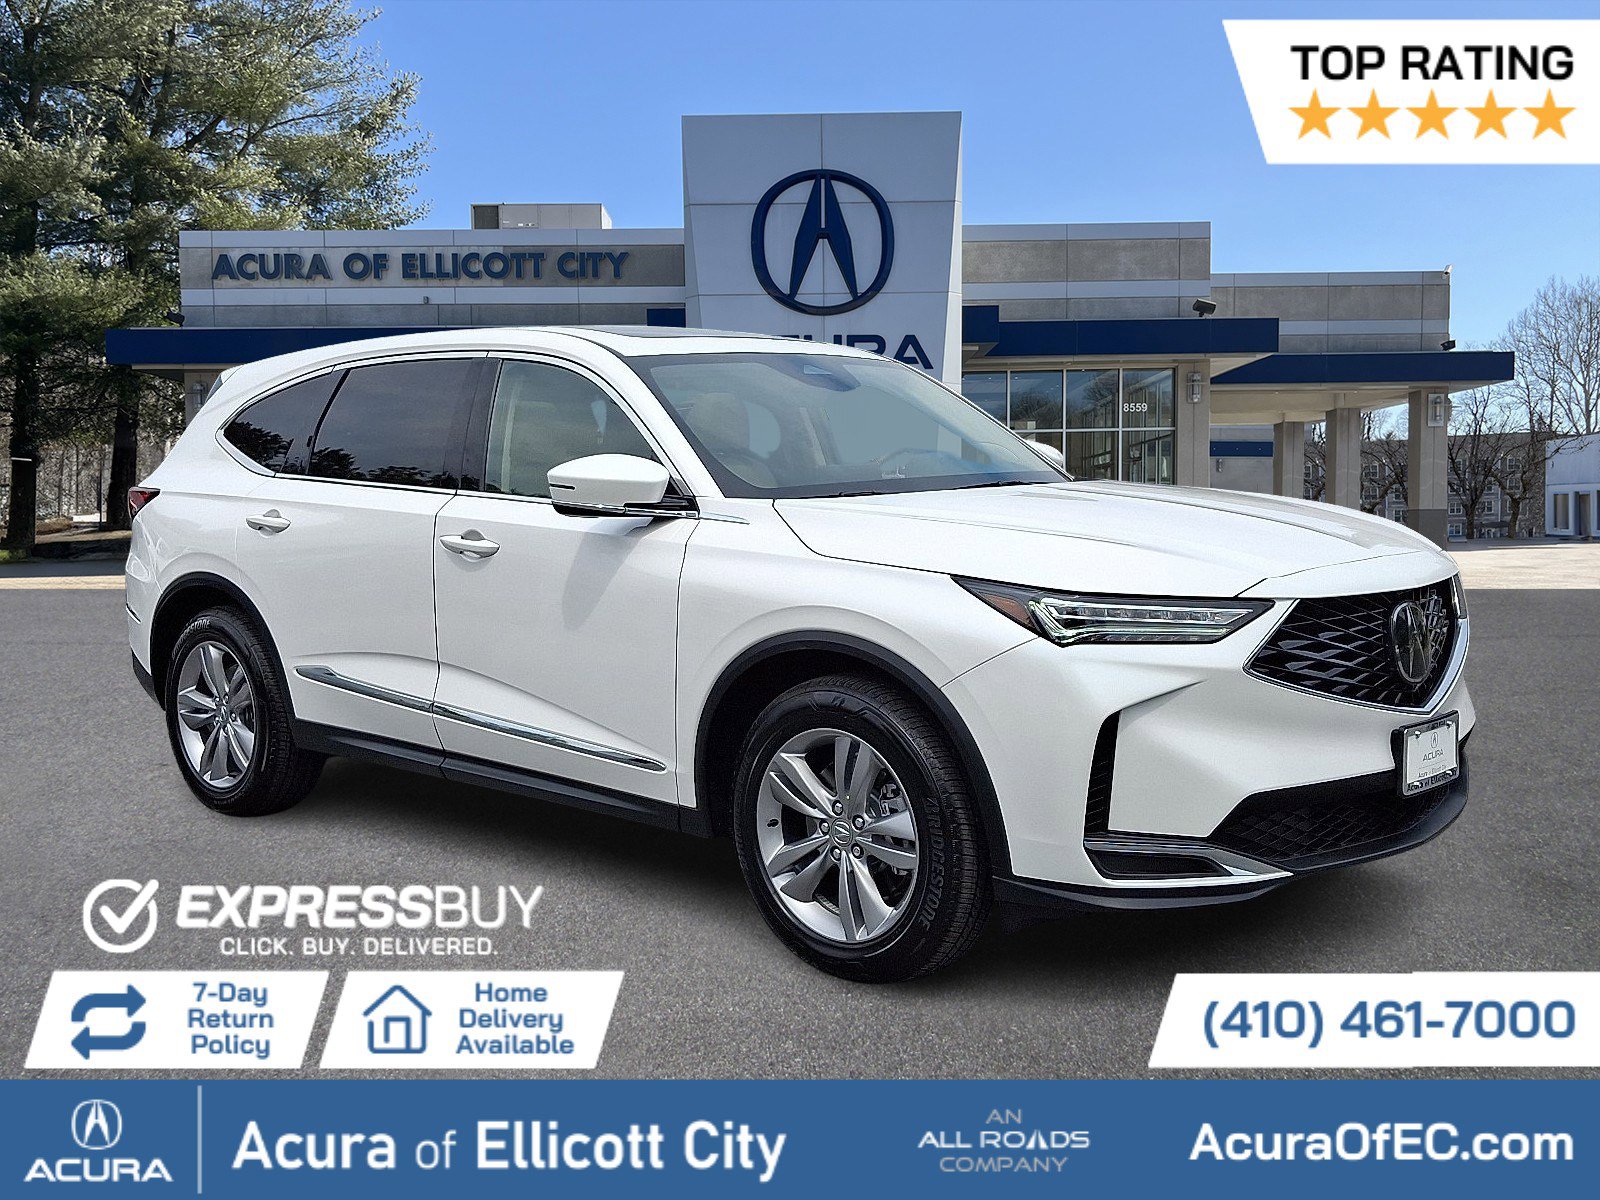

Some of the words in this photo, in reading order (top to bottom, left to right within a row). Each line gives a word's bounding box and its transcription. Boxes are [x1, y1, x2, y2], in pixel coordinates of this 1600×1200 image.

[211, 253, 332, 280] ACURA
[343, 252, 389, 280] OF
[401, 252, 547, 279] ELLICOTT
[557, 251, 629, 279] CITY
[1123, 402, 1148, 412] 8559
[1423, 749, 1444, 761] ACURA
